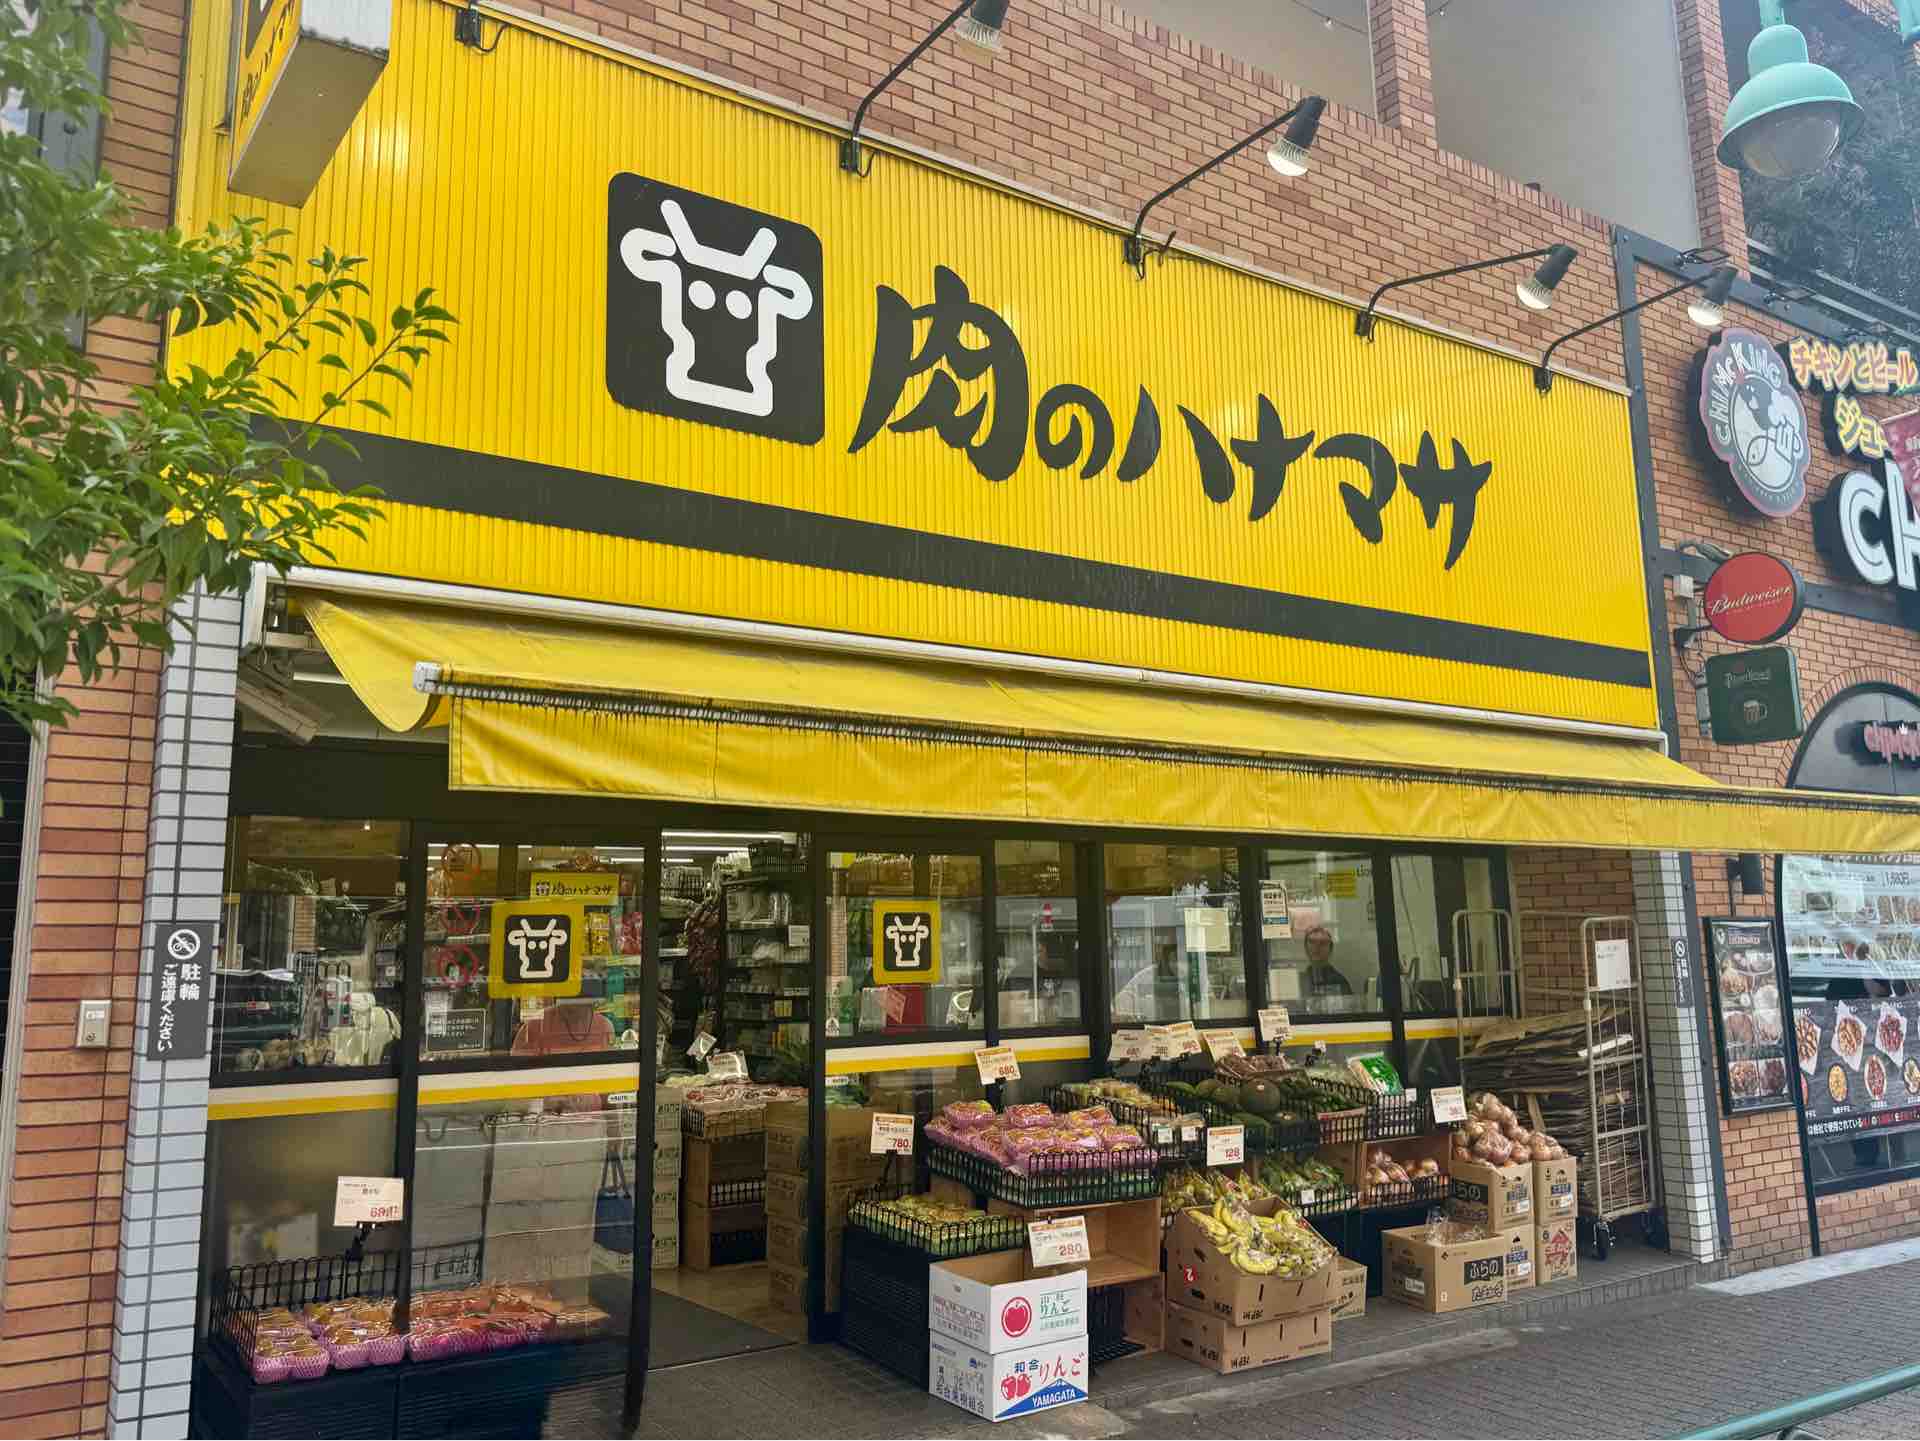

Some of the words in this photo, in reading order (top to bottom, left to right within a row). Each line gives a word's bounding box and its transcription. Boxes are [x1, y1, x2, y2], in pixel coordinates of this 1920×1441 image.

[1789, 337, 1919, 392] チキンとビール
[848, 265, 1492, 571] 肉のハナマサ
[1711, 584, 1793, 616] Budweiser
[180, 963, 201, 1001] 駐輪
[157, 963, 178, 1052] ご遠慮ください
[1059, 1243, 1082, 1257] 280
[1032, 1389, 1076, 1408] YAMAGATA
